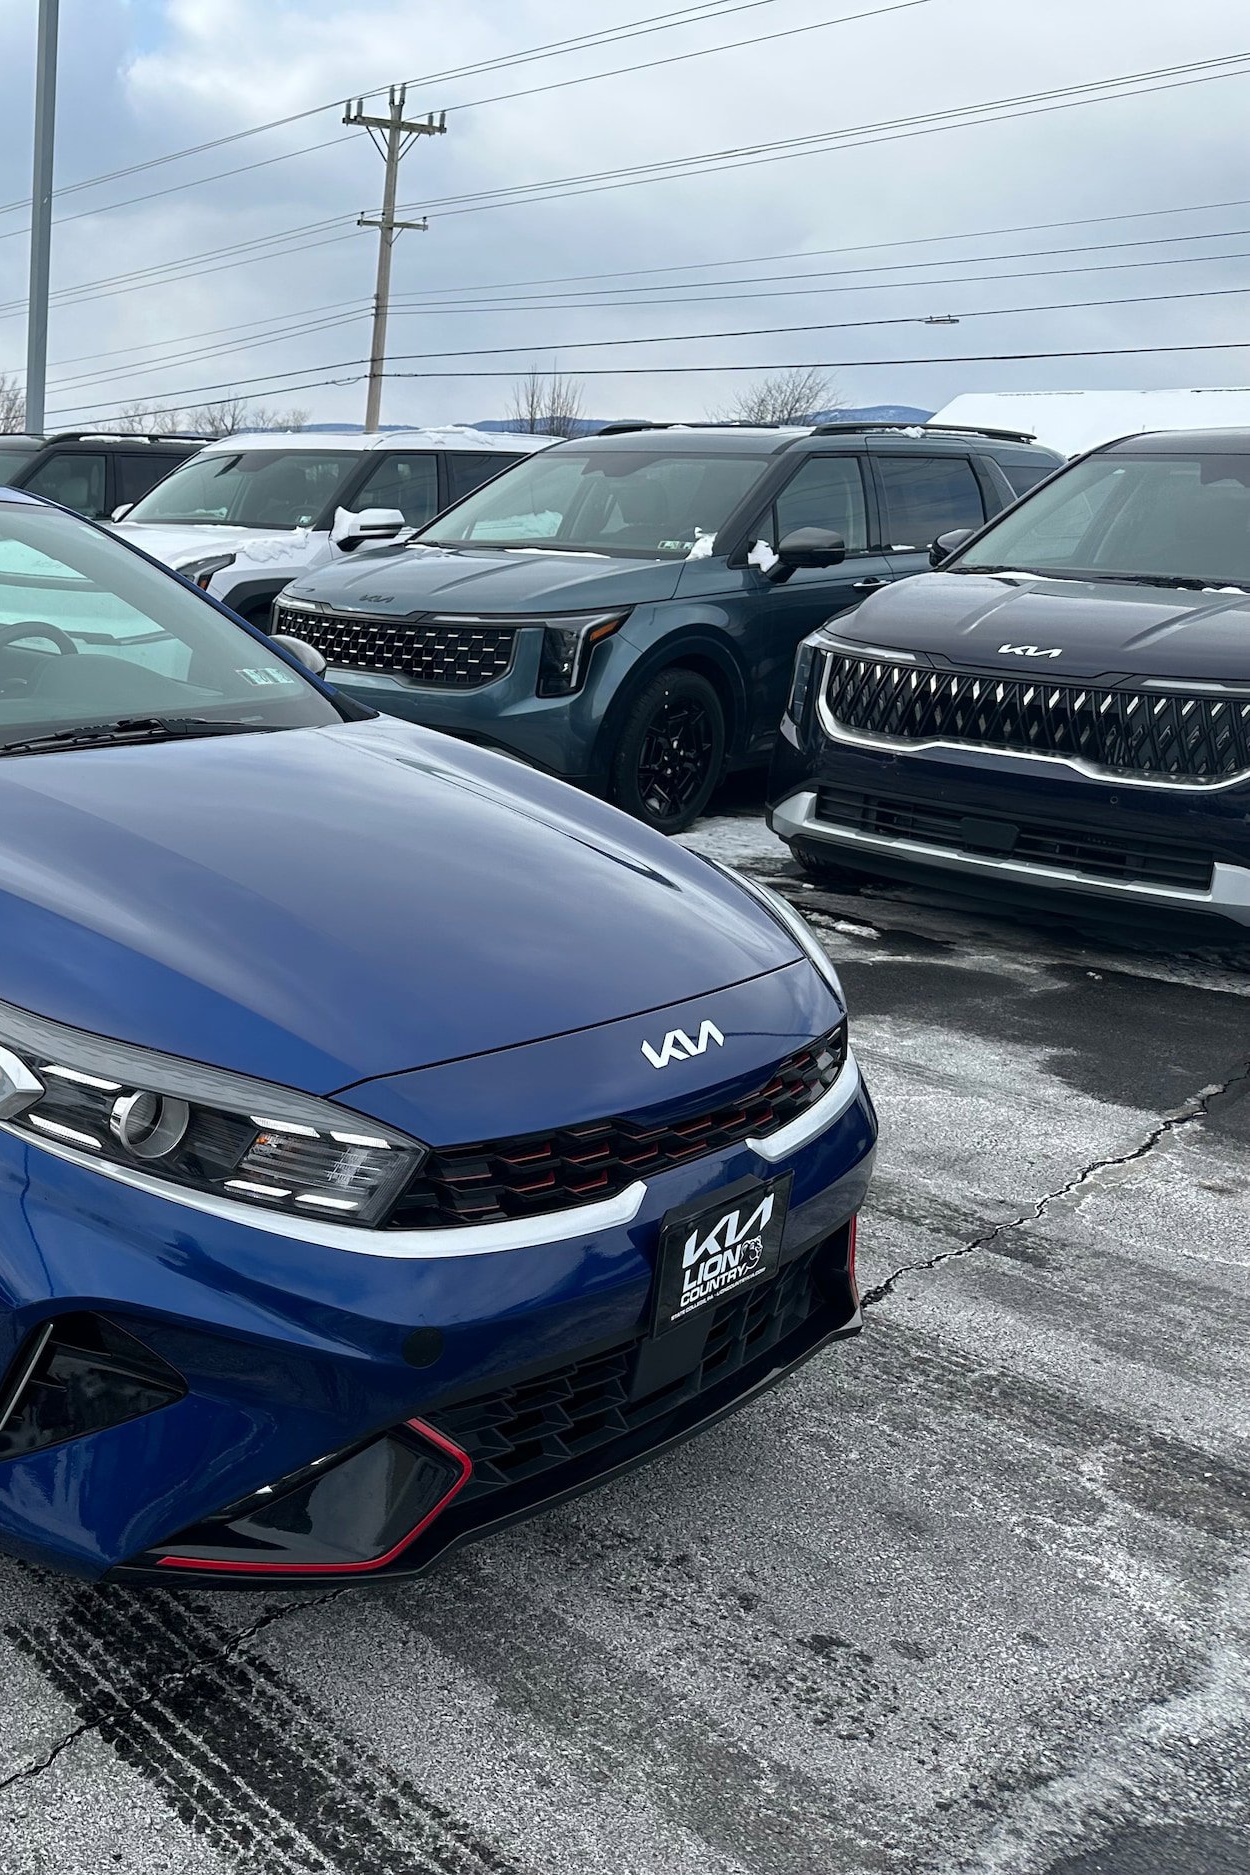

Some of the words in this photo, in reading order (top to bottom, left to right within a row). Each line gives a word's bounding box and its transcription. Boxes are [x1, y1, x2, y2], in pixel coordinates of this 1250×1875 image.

[997, 643, 1062, 659] KIA
[640, 1019, 725, 1069] KIA
[682, 1192, 775, 1269] KIA
[680, 1262, 747, 1308] COUNTRY
[682, 1243, 742, 1294] LION
